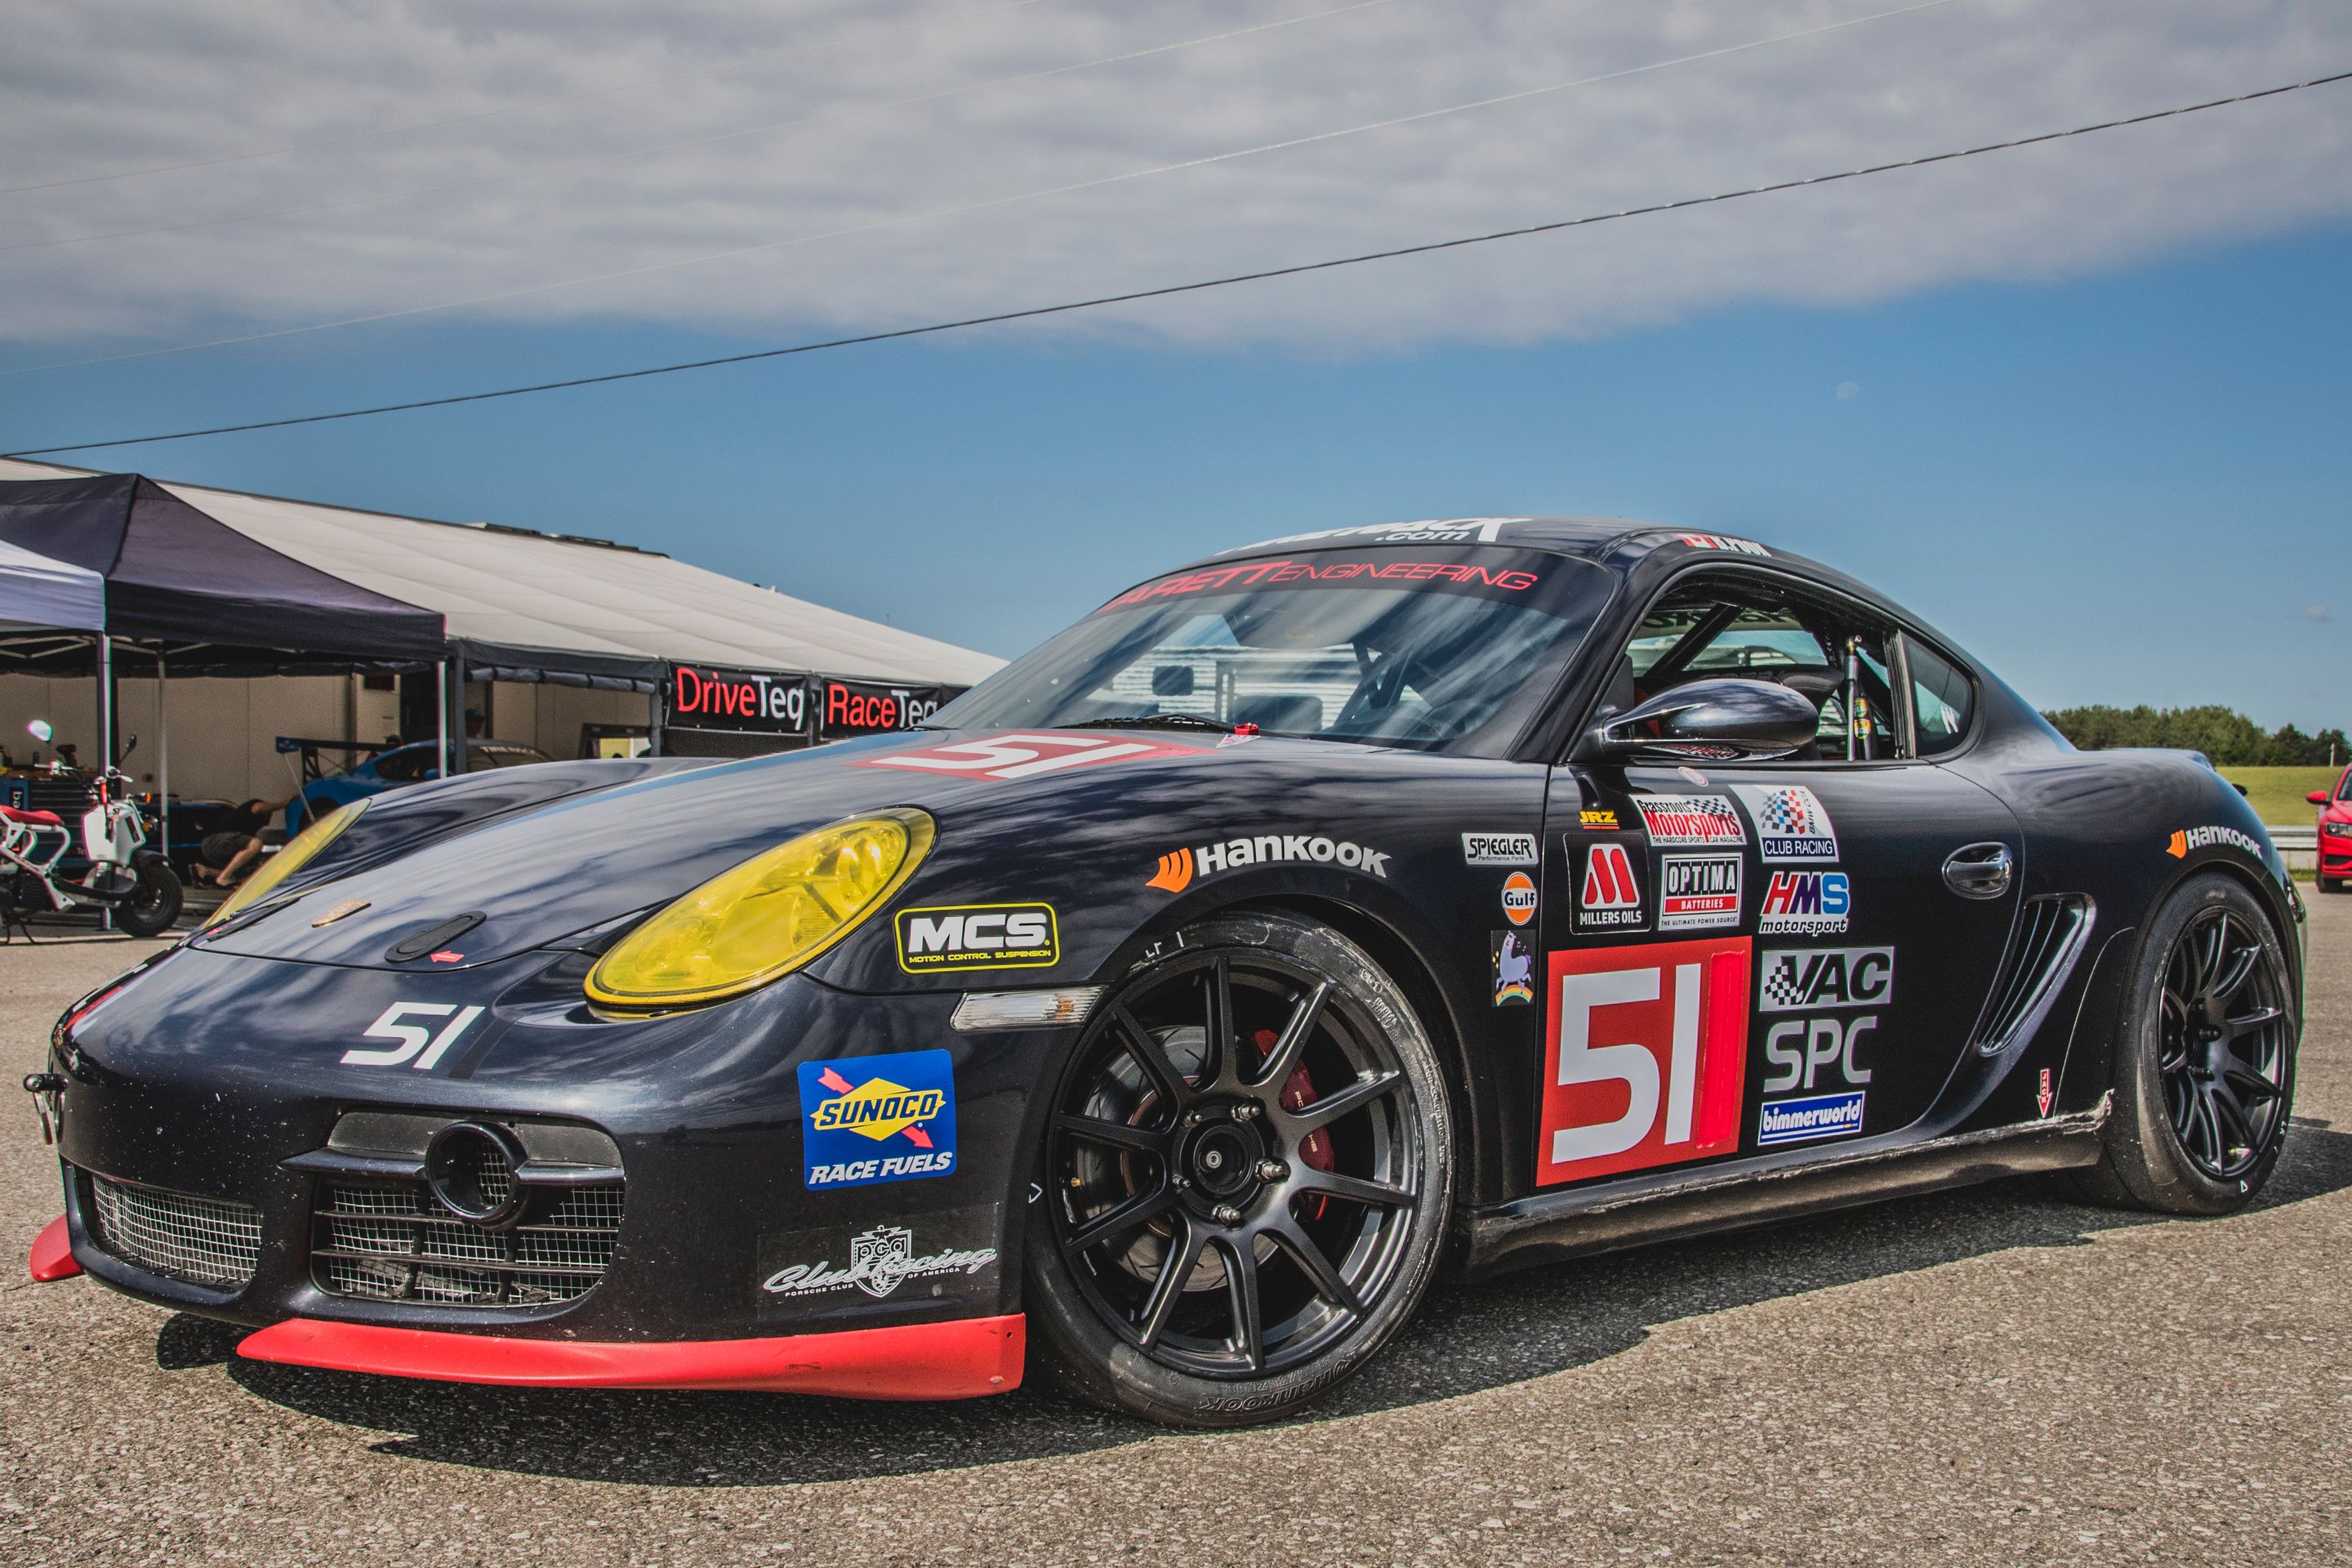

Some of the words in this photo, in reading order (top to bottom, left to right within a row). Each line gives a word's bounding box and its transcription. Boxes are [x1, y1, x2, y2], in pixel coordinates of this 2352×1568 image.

[1375, 531, 1470, 541] .com
[1268, 564, 1538, 590] ENGINEERING
[677, 667, 805, 731] DriveTeq
[871, 735, 1156, 779] 51
[1579, 810, 1618, 823] JRZ
[1637, 800, 1693, 814] Grassroots
[1643, 811, 1741, 842] Motorsports
[1806, 810, 1816, 835] BMW
[1468, 838, 1533, 859] SPIEGLER
[1765, 840, 1793, 854] CLUB
[1795, 840, 1833, 854] RACING
[1668, 865, 1735, 893] OPTIMA
[1504, 891, 1535, 906] Gulf
[1681, 899, 1724, 910] BATTERIES
[1762, 874, 1850, 915] HMS
[1579, 911, 1621, 925] MILLERS
[1622, 911, 1642, 923] OILS
[1761, 919, 1847, 936] motorsport
[908, 913, 1048, 953] MCS
[909, 955, 944, 963] MOTION
[948, 952, 991, 960] CONTROL
[995, 950, 1051, 959] SUSPENSION
[1771, 952, 1891, 1006] VAC
[340, 1001, 486, 1070] 51
[1552, 964, 1701, 1164] 51
[1763, 1016, 1878, 1093] SPC
[819, 1093, 939, 1127] SUNOCO
[1762, 1099, 1862, 1132] bimmerworld
[808, 1160, 880, 1184] RACE
[880, 1152, 953, 1177] FUELS
[858, 1236, 907, 1258] pca
[785, 1287, 827, 1298] PORSCHE
[831, 1283, 854, 1291] CLUB
[922, 1267, 960, 1277] AMERICA
